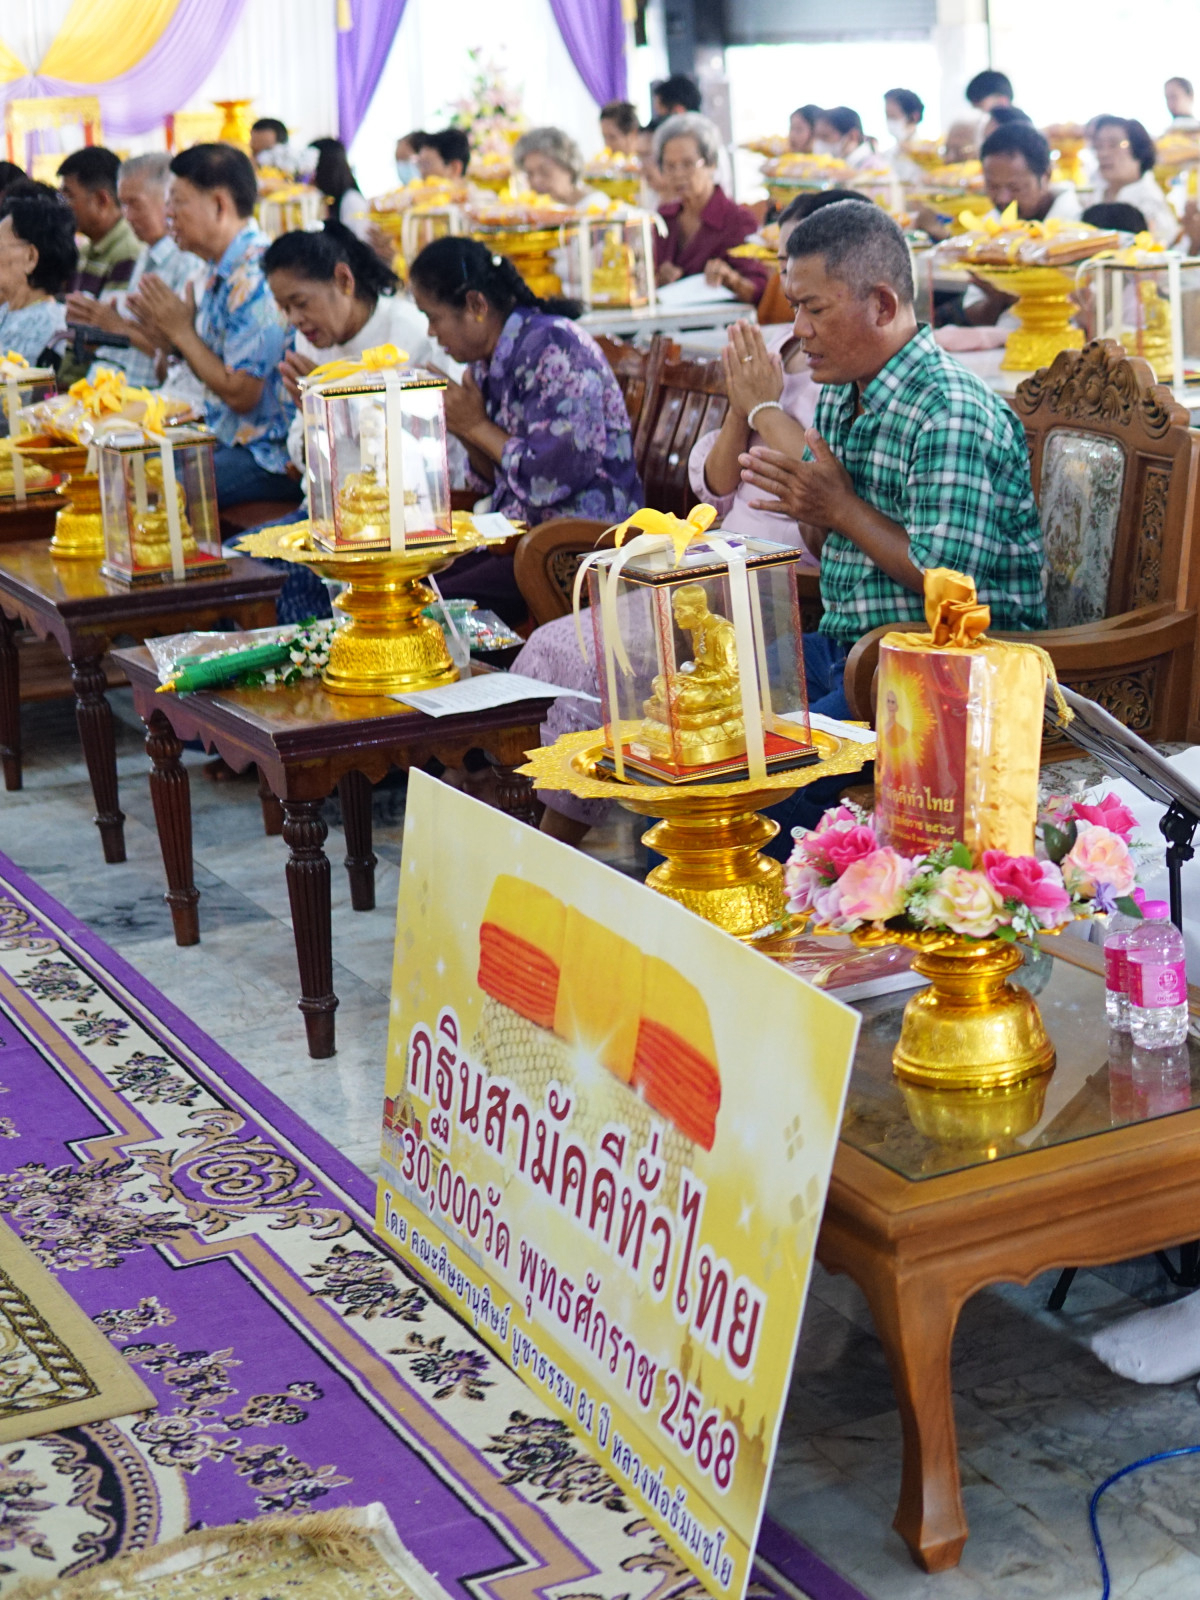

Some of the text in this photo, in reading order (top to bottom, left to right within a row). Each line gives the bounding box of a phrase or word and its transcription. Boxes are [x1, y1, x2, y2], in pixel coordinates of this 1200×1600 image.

[402, 1132, 735, 1489] 30,000วัด พุทธศักราช 2568
[410, 1014, 761, 1369] กฐินสามัคคีทั่วไทย
[385, 1192, 732, 1587] โดย คณะศิษยานุศิษย์ บูชาธรรม 81 ปี หลวงพ่อธัมมชโย
